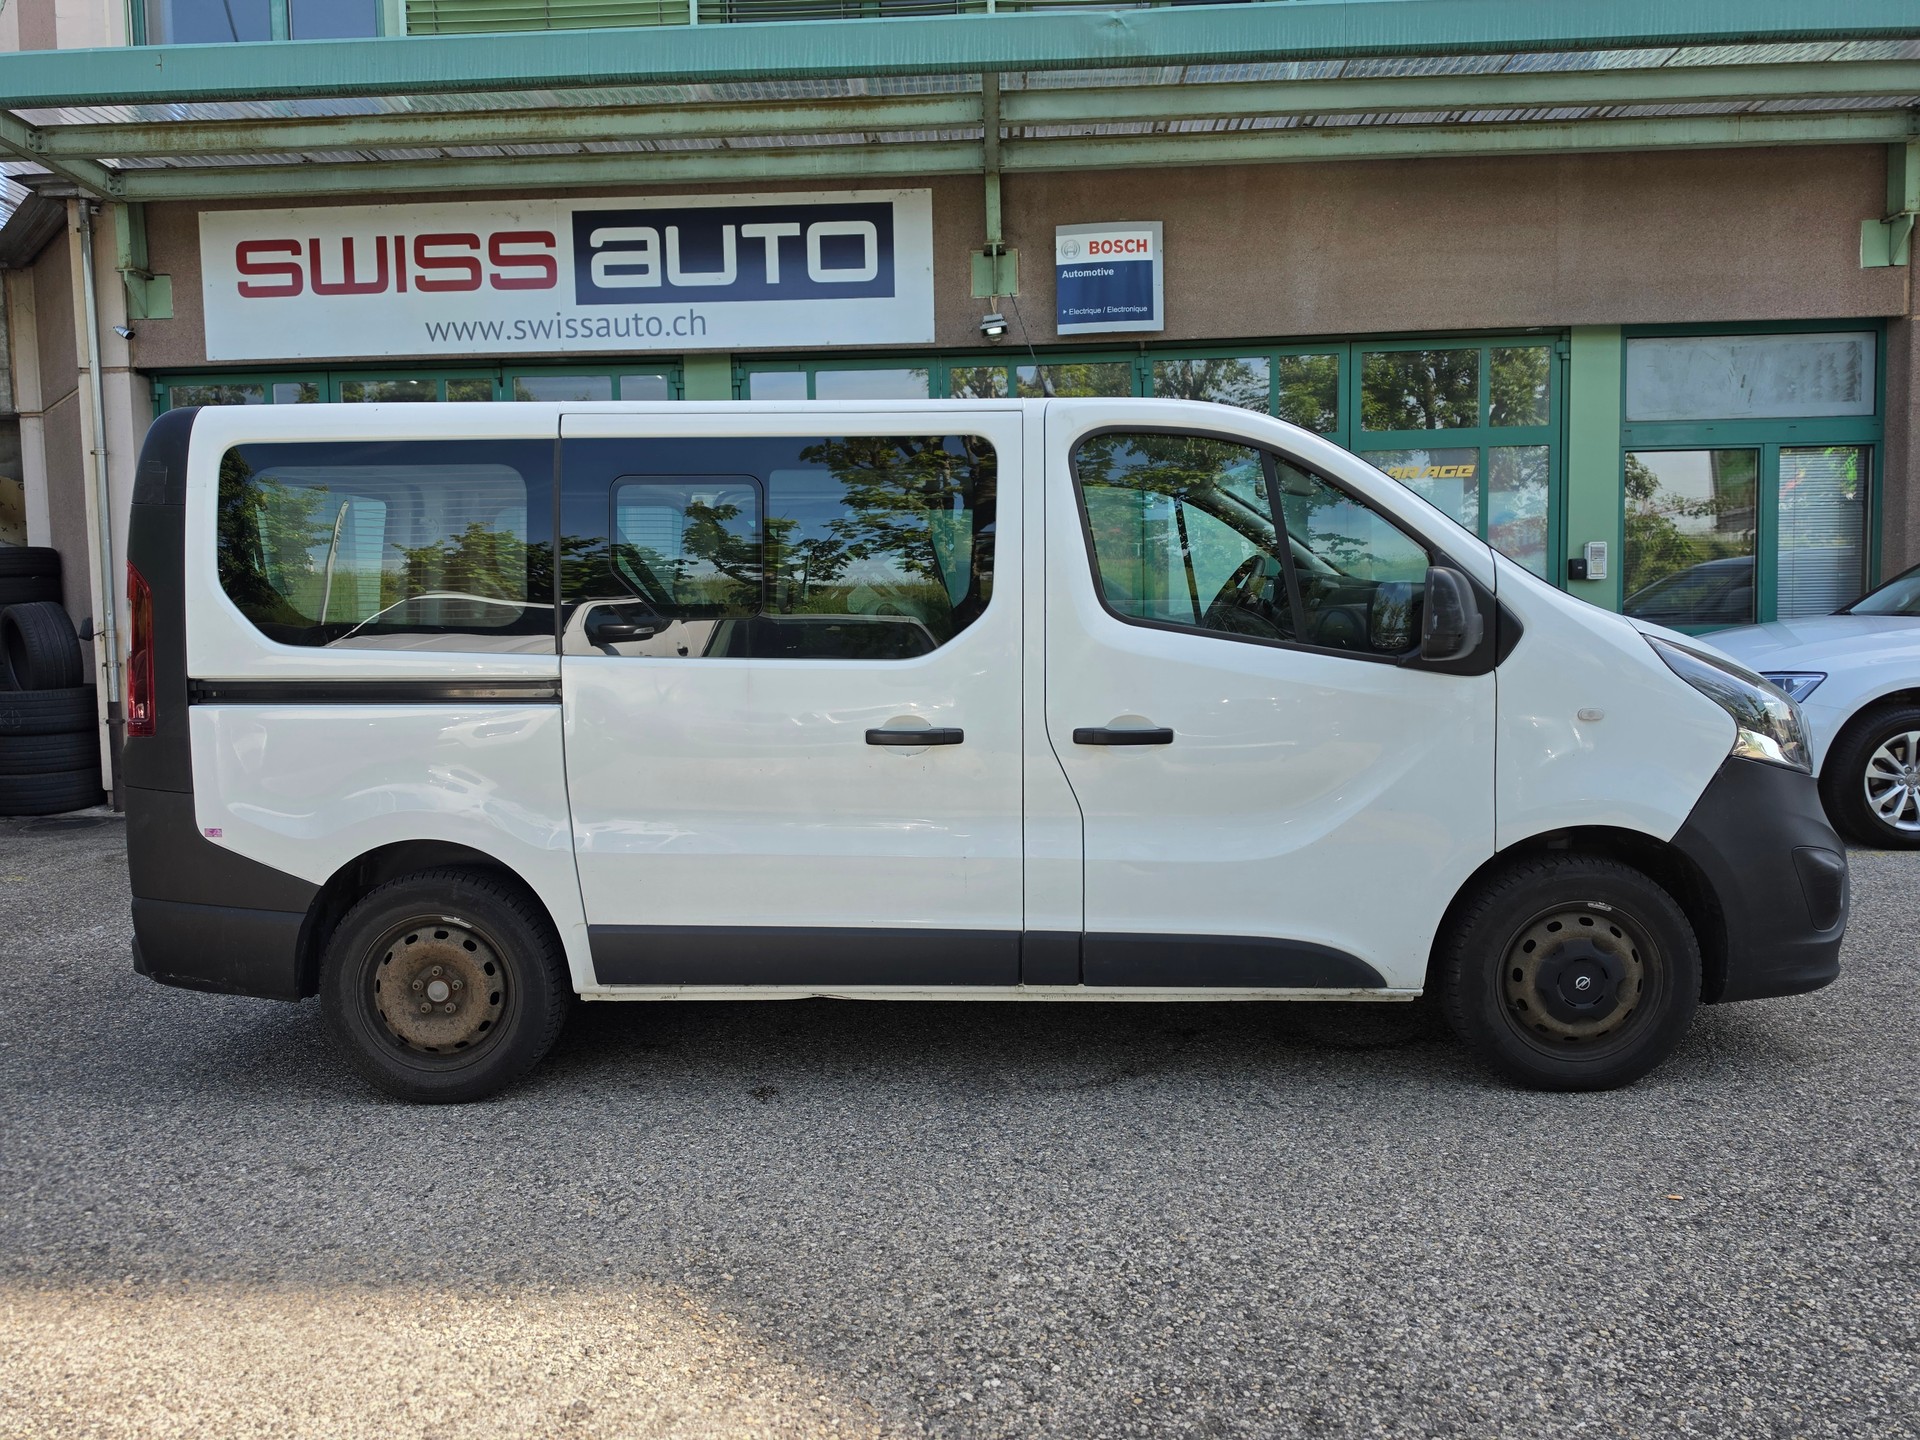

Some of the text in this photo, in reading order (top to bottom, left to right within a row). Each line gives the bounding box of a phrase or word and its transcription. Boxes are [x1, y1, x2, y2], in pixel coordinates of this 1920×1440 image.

[1088, 238, 1148, 255] BOSCH
[235, 230, 558, 298] SWISS
[1061, 267, 1115, 279] Automotive
[1068, 307, 1102, 316] Electrique
[1106, 305, 1148, 314] Electronique
[424, 309, 708, 343] www.swissauto.ch
